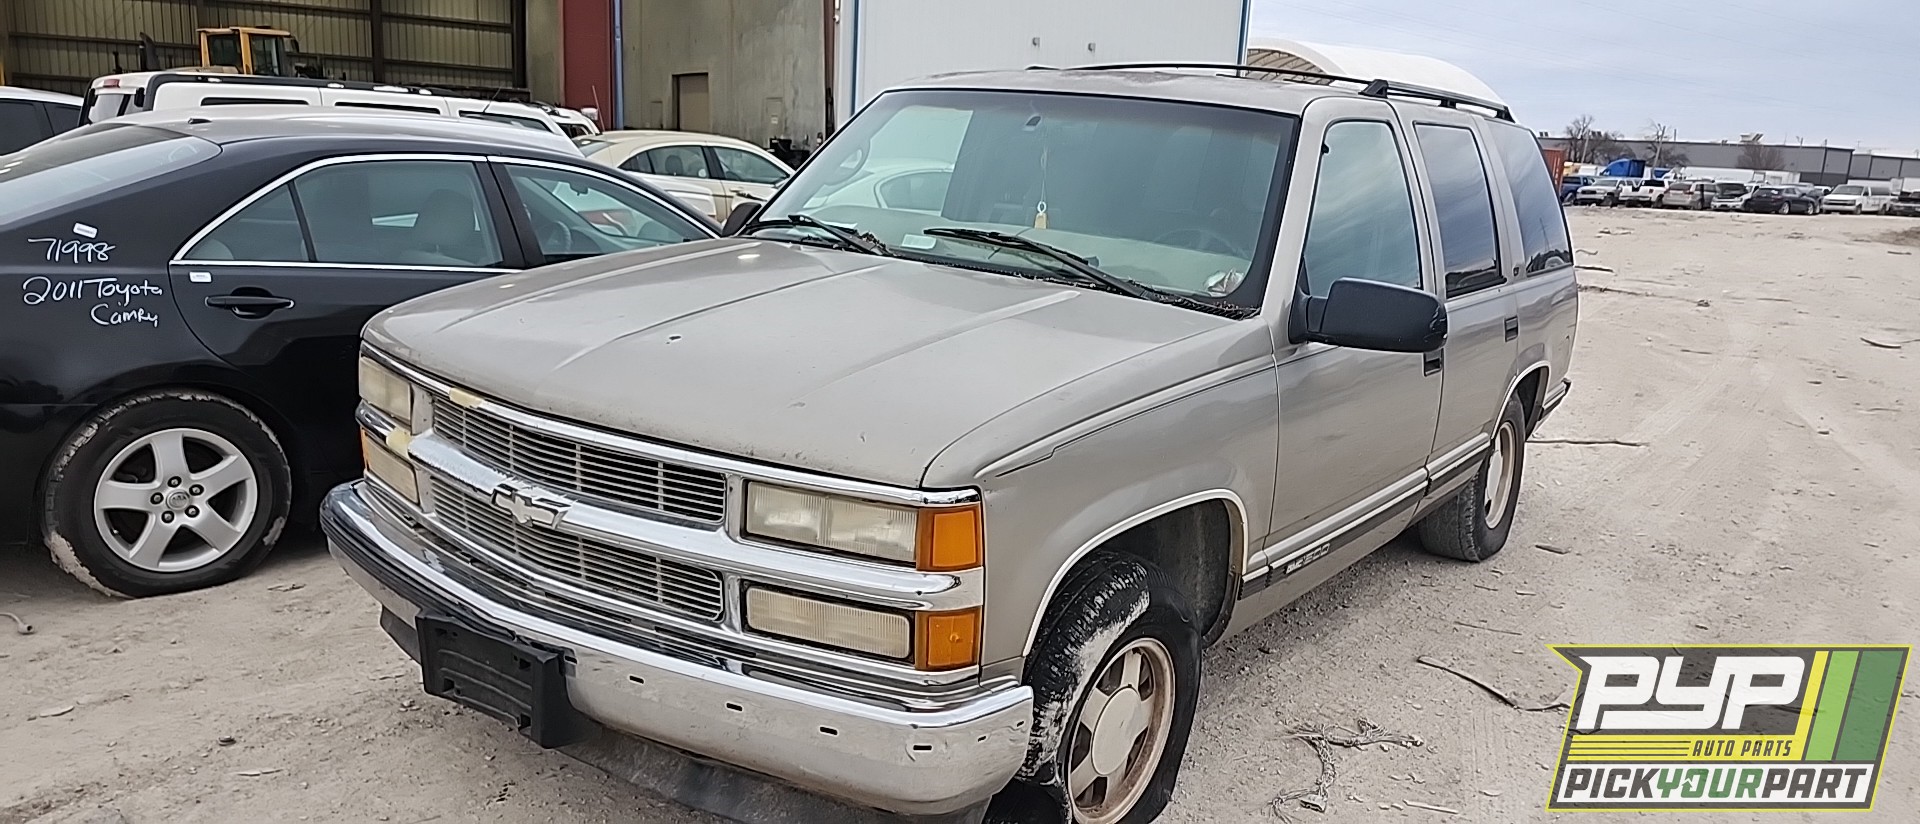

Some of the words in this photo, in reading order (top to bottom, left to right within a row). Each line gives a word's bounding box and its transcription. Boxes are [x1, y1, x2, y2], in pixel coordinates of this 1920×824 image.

[28, 238, 116, 263] 71998
[23, 276, 83, 305] 2011
[84, 278, 162, 307] Toyota
